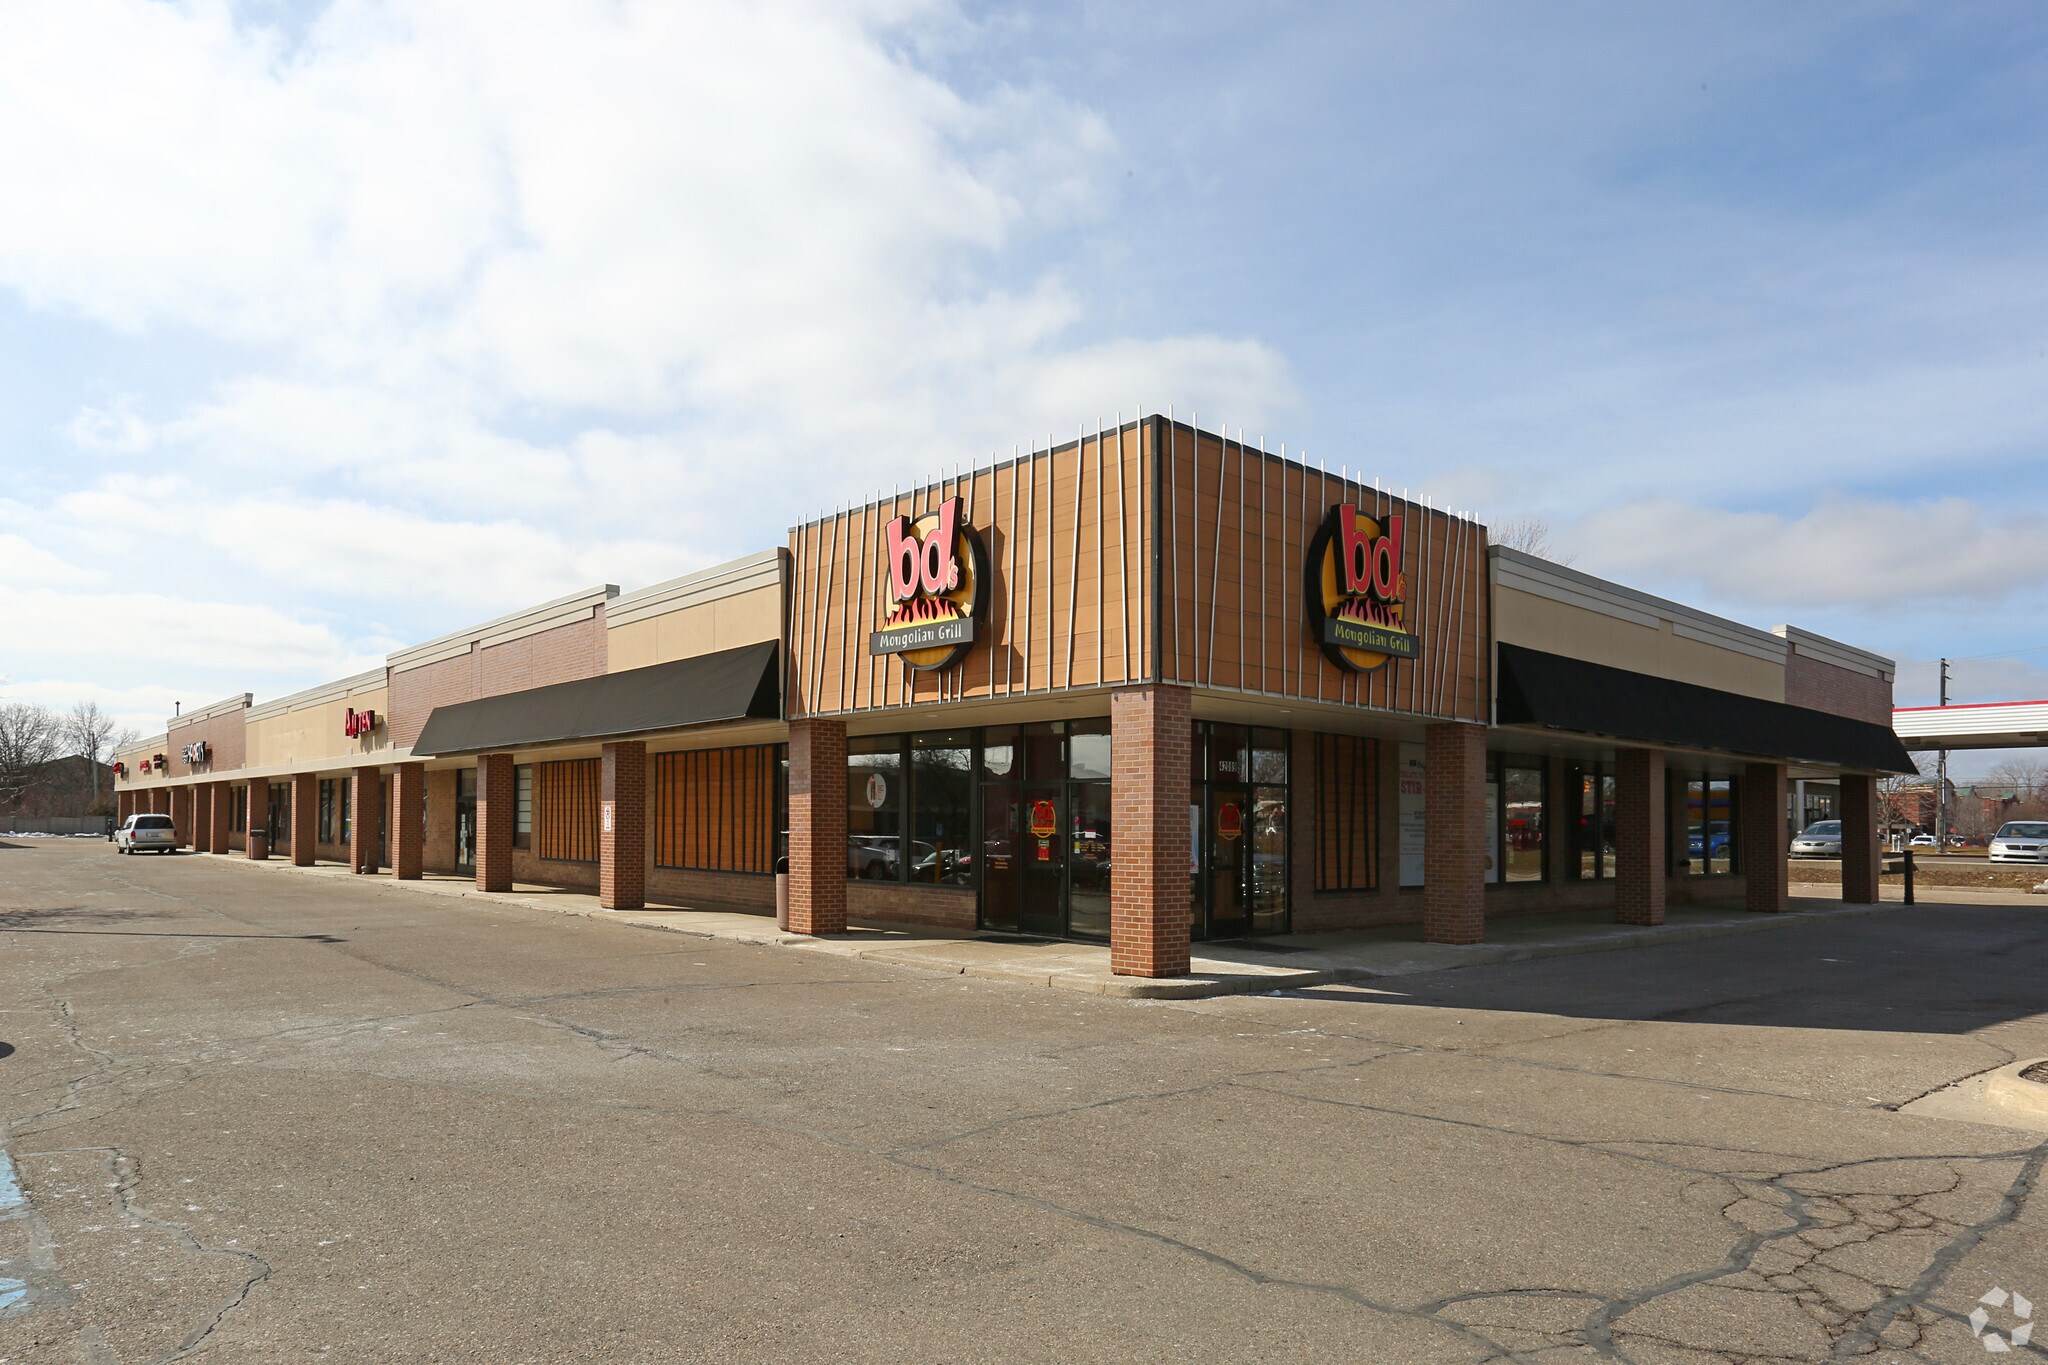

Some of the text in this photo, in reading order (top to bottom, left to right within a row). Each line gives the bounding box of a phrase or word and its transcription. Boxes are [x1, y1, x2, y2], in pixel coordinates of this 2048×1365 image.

[879, 623, 962, 649] Mongolian Grill
[1334, 623, 1411, 653] Mongolian Grill
